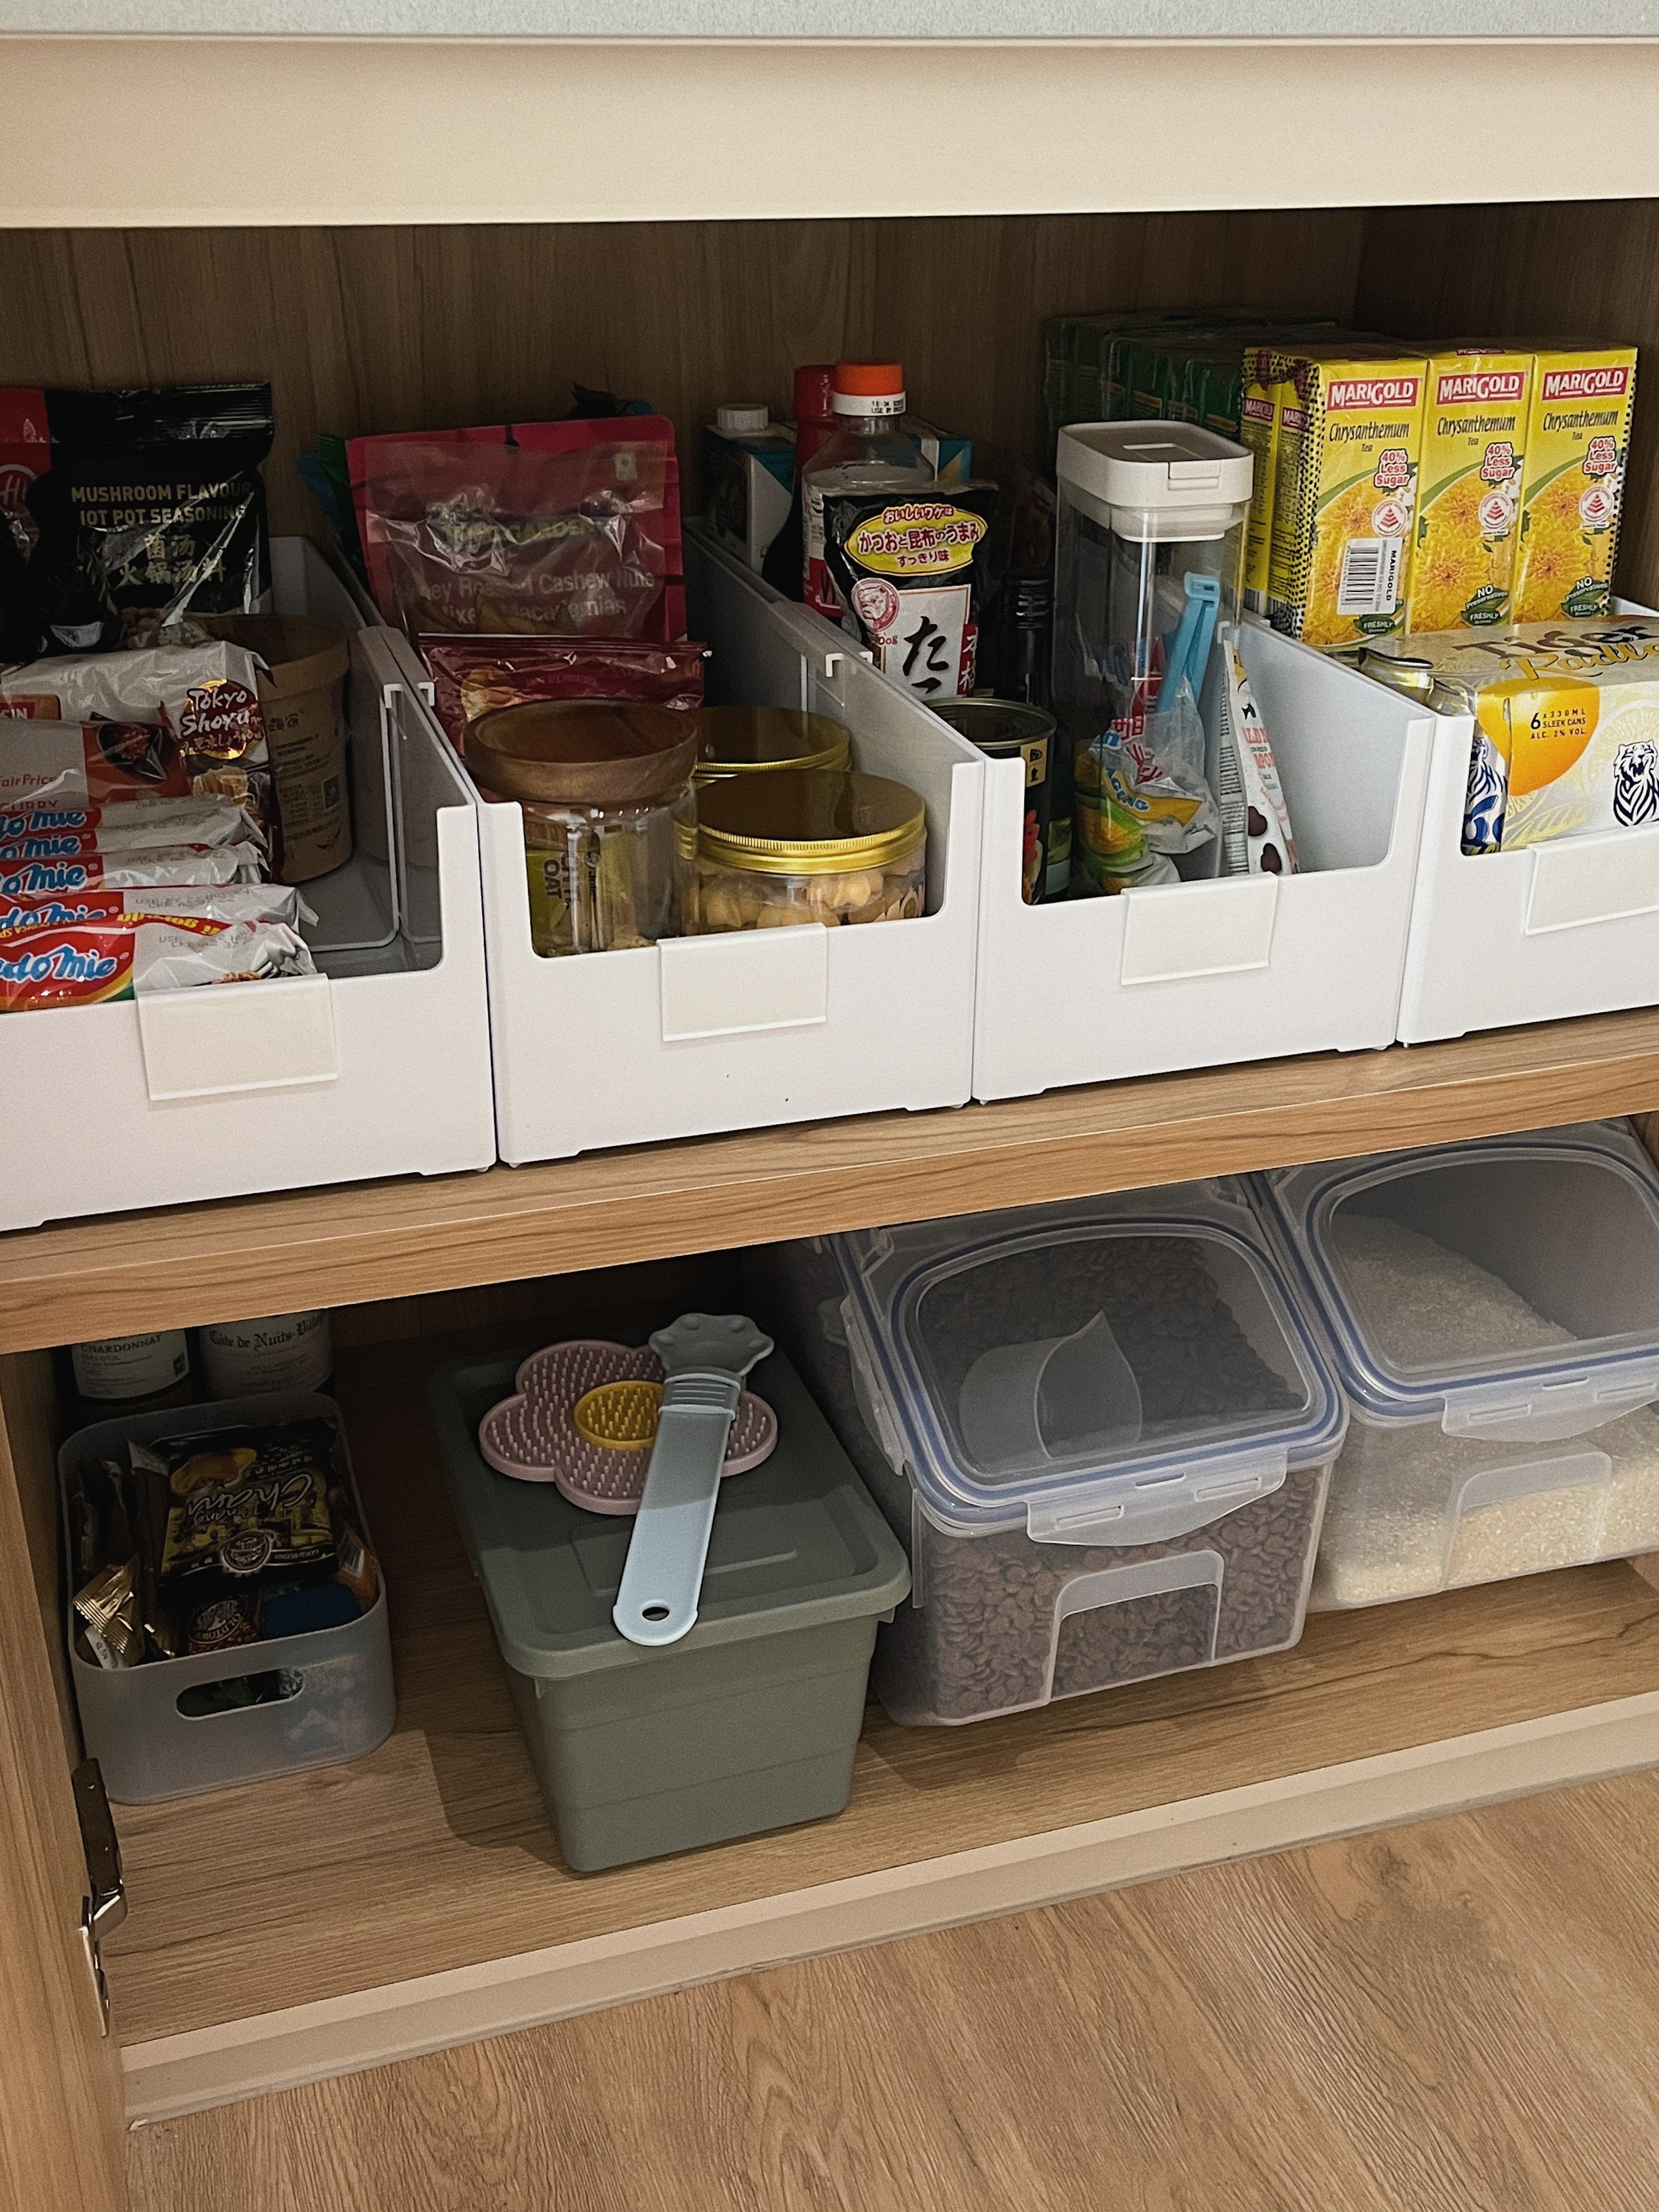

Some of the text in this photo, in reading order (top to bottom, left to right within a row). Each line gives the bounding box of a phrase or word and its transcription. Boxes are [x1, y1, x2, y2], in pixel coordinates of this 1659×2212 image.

[1440, 375, 1520, 402] MARIGOLD
[1545, 370, 1625, 397] MARIGOLD
[1331, 381, 1414, 408] MARIGOLD
[1437, 415, 1516, 437] Chrysanthemum
[1543, 410, 1619, 432] Chrysanthemum
[1329, 421, 1409, 444] Chrysanthemum
[1487, 443, 1511, 456] 40%
[1591, 438, 1615, 450] 40%
[1381, 450, 1407, 462] 40%
[1486, 458, 1511, 466] Less
[1590, 452, 1614, 461] Less
[1380, 464, 1406, 473] Less
[1482, 467, 1514, 480] Sugar
[1585, 461, 1617, 473] Sugar
[1376, 475, 1409, 487] Sugar
[71, 482, 250, 503] MUSHROOM FLAVOUR
[112, 508, 146, 525] POT
[150, 503, 246, 524] SEASONING
[1386, 550, 1397, 601] MARIGOLD
[1576, 577, 1593, 590] NO
[1477, 584, 1493, 598] NO
[1470, 612, 1499, 621] FRESHLY
[1570, 604, 1599, 614] FRESHLY
[1363, 620, 1394, 629] FRESHLY
[1499, 642, 1659, 681] Radle
[188, 687, 247, 711] Tokyo
[1530, 712, 1586, 730] 6 SLEEK CANS
[0, 774, 57, 787] airPrice
[0, 861, 88, 894] omie
[544, 859, 562, 900] OAT
[0, 943, 118, 984] domie
[81, 1334, 162, 1353] CHARDONNAY
